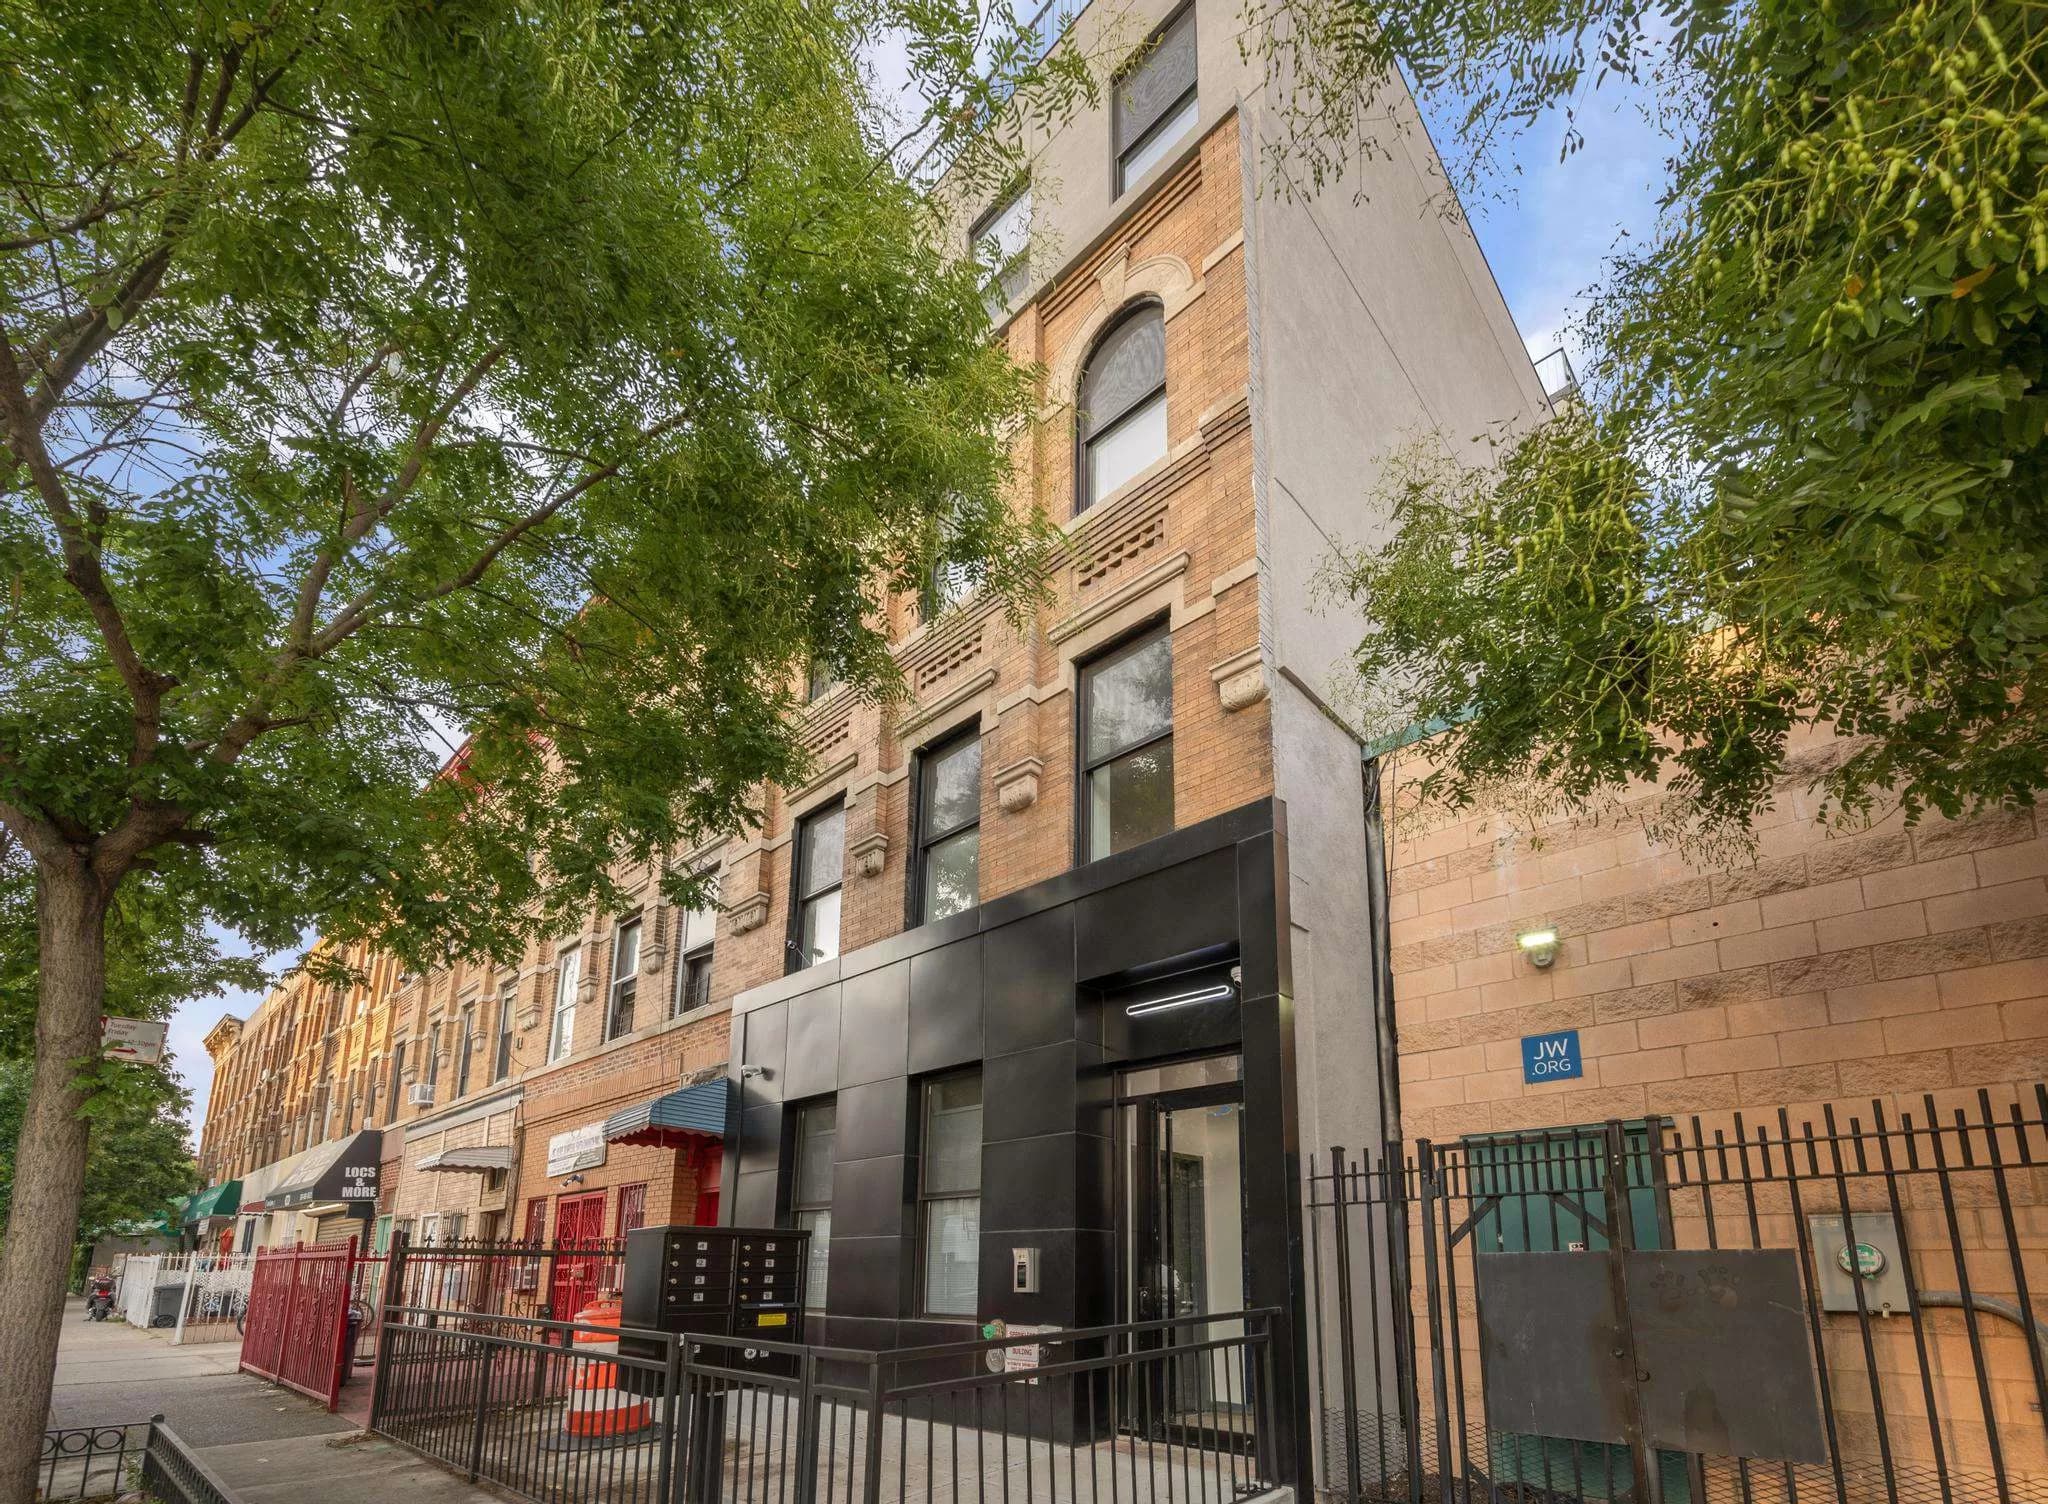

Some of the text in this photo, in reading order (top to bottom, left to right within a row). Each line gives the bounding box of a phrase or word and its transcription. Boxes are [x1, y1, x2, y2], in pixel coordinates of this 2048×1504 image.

[110, 1021, 136, 1031] Tuesday
[1533, 1038, 1568, 1060] JW
[1532, 1058, 1571, 1076] .ORG
[345, 1166, 376, 1178] LOCS
[355, 1178, 365, 1187] &
[342, 1186, 377, 1198] MORE
